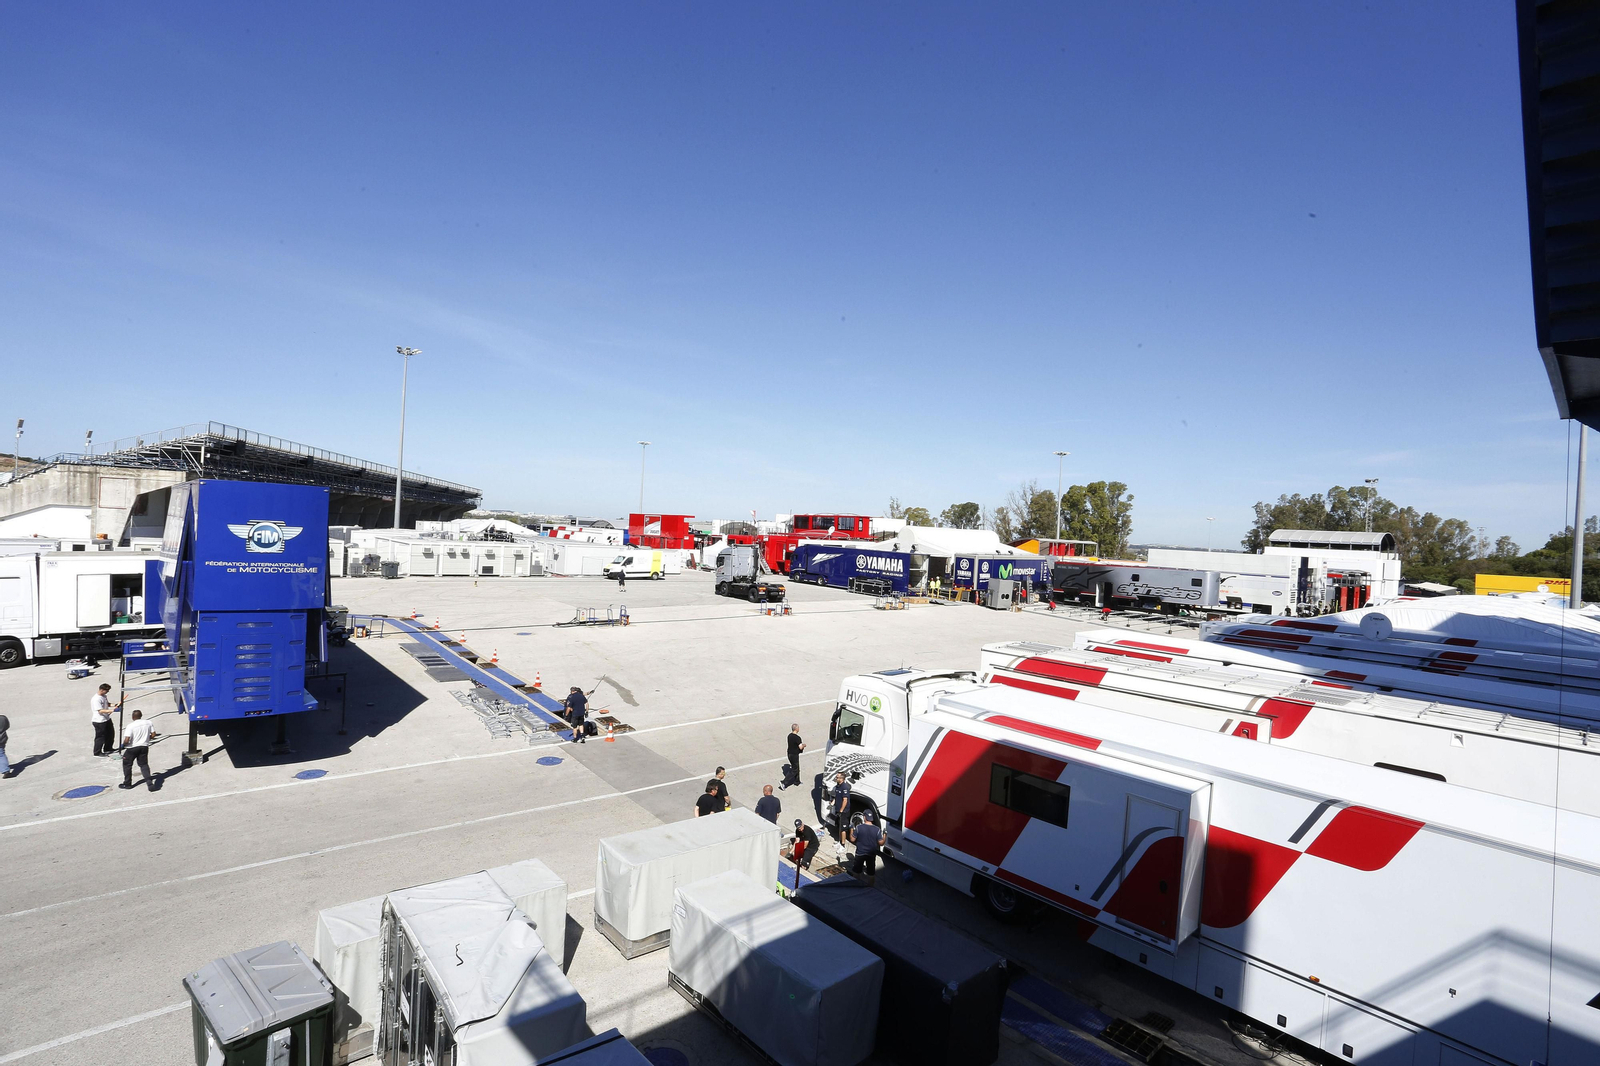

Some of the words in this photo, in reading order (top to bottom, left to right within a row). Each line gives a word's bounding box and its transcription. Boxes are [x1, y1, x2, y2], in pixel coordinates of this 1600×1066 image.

[253, 530, 279, 544] FIM
[866, 555, 904, 573] YAMAHA
[1116, 582, 1203, 600] alpinestars
[846, 689, 868, 706] HVO
